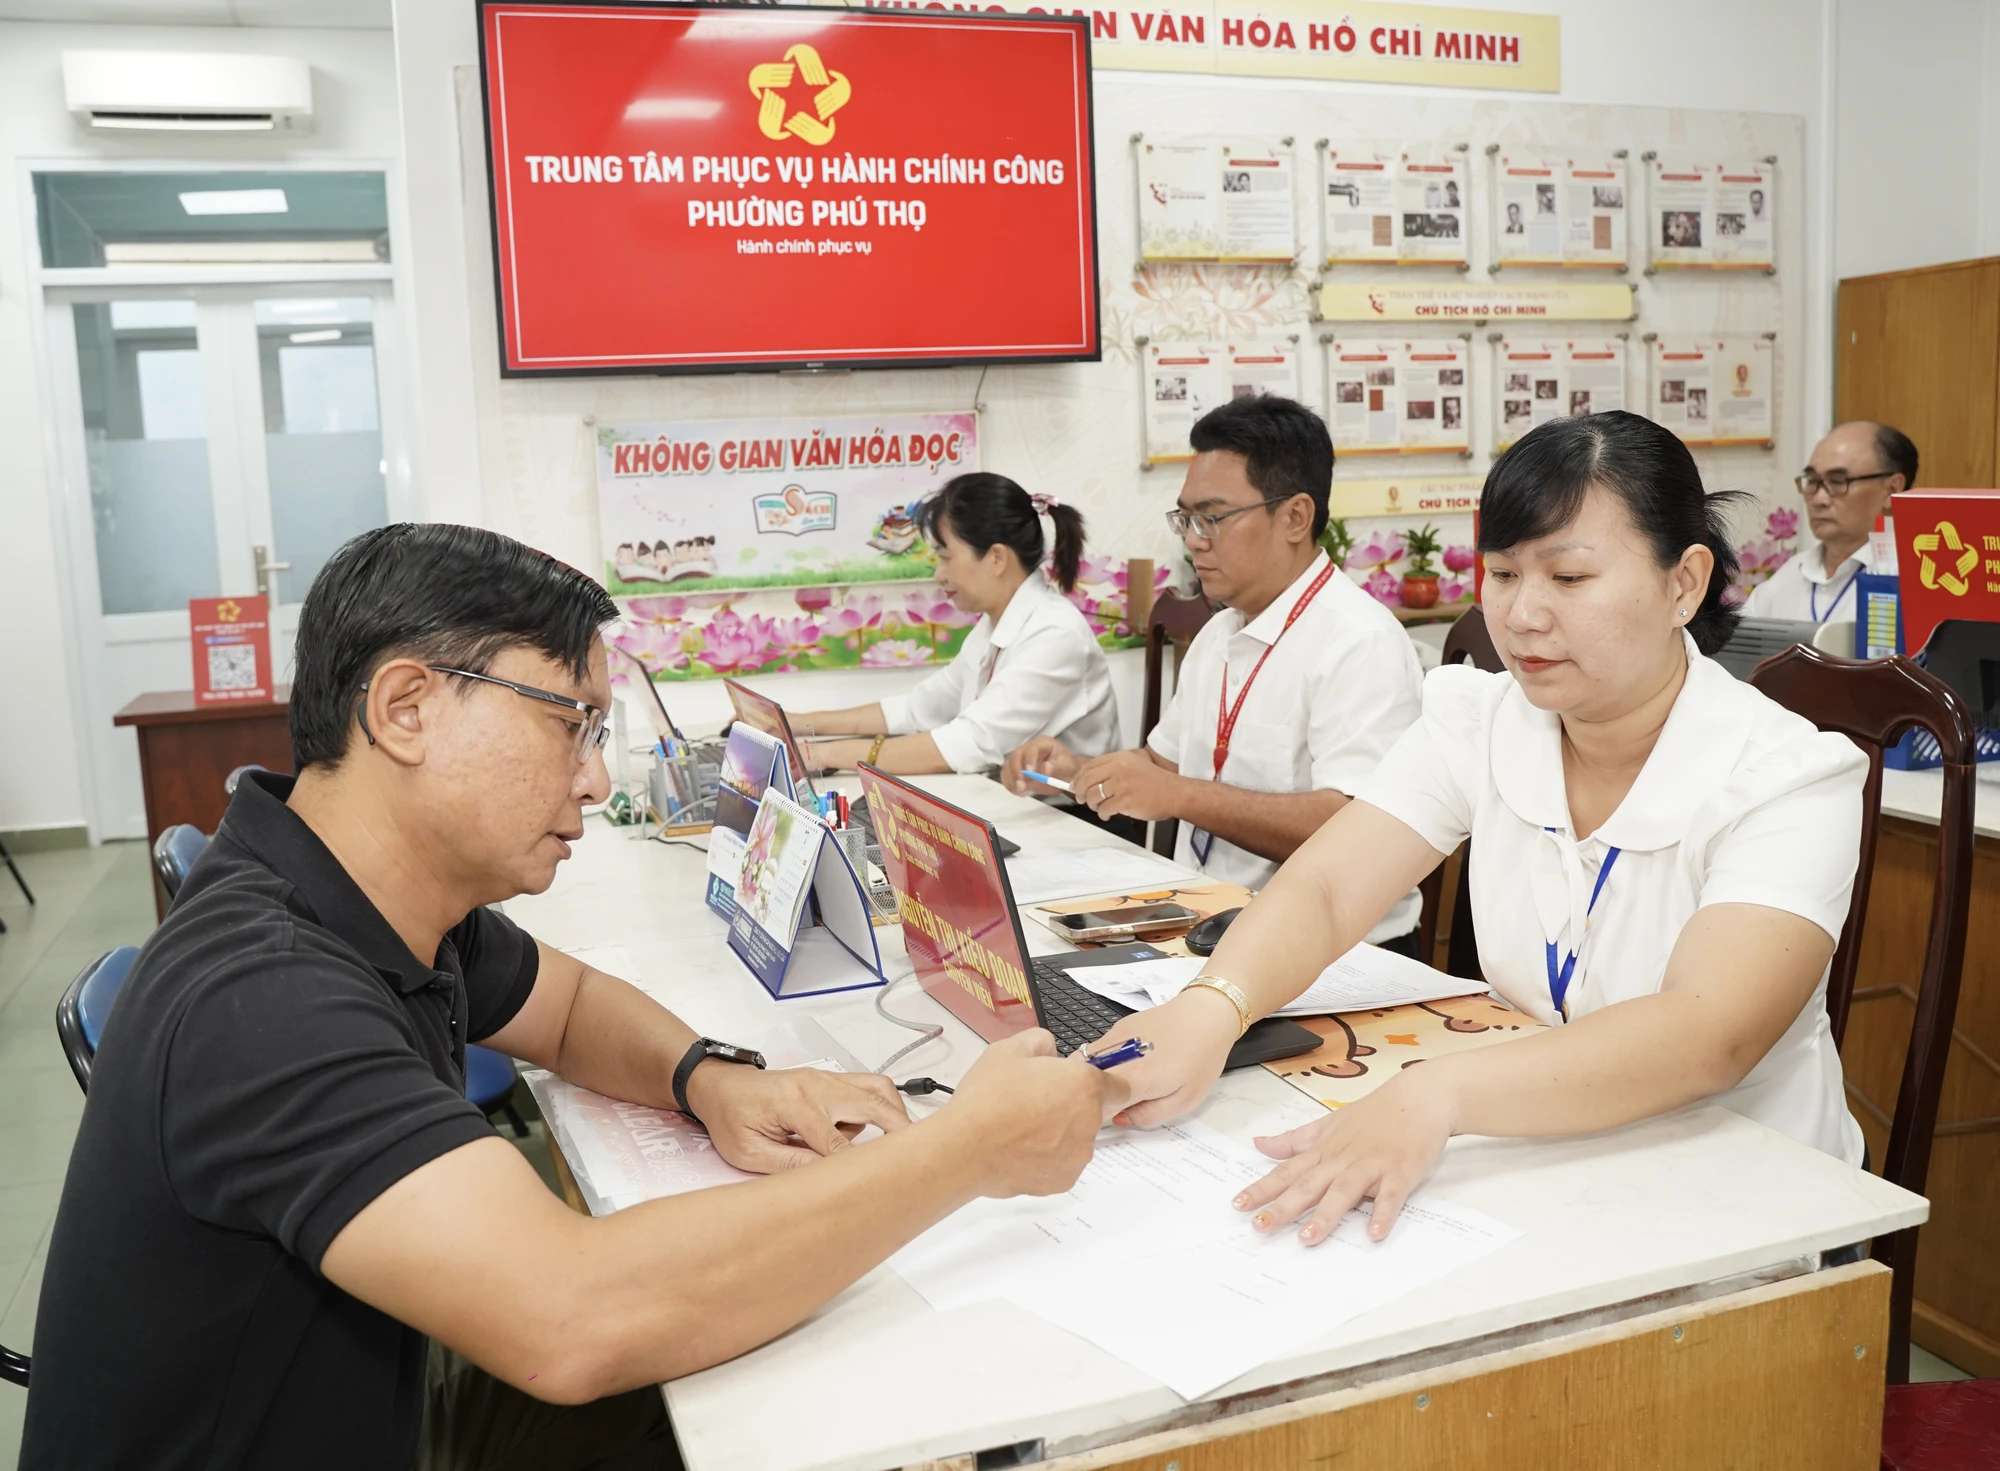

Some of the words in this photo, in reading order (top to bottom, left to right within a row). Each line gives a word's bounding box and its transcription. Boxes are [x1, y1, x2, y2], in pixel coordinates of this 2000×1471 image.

[1130, 9, 1204, 43] VĂN
[1222, 13, 1296, 49] HÓA
[1309, 16, 1356, 53] HỒ
[1370, 23, 1421, 56] CHÍ
[1434, 32, 1519, 63] MINH
[524, 156, 623, 183] TRUNG
[628, 150, 684, 183] TÂM
[692, 156, 770, 189] PHỤC
[775, 156, 814, 189] VỤ
[821, 152, 896, 184] HÀNH
[903, 153, 986, 184] CHÍNH
[993, 154, 1064, 185] CÔNG
[687, 195, 804, 227] PHƯỜNG
[811, 195, 868, 227] PHÚ
[873, 200, 927, 232] THỌ
[736, 239, 773, 254] Hành
[776, 238, 815, 254] chính
[818, 238, 853, 256] phục
[854, 241, 872, 255] vụ
[1515, 305, 1546, 315] MINH
[615, 434, 711, 474] KHÔNG
[719, 439, 783, 469] GIAN
[791, 429, 842, 467] VĂN
[849, 427, 902, 465] HÓA
[908, 433, 960, 471] ĐỌC
[935, 914, 962, 966] THỊ
[972, 980, 995, 1012] VIÊN
